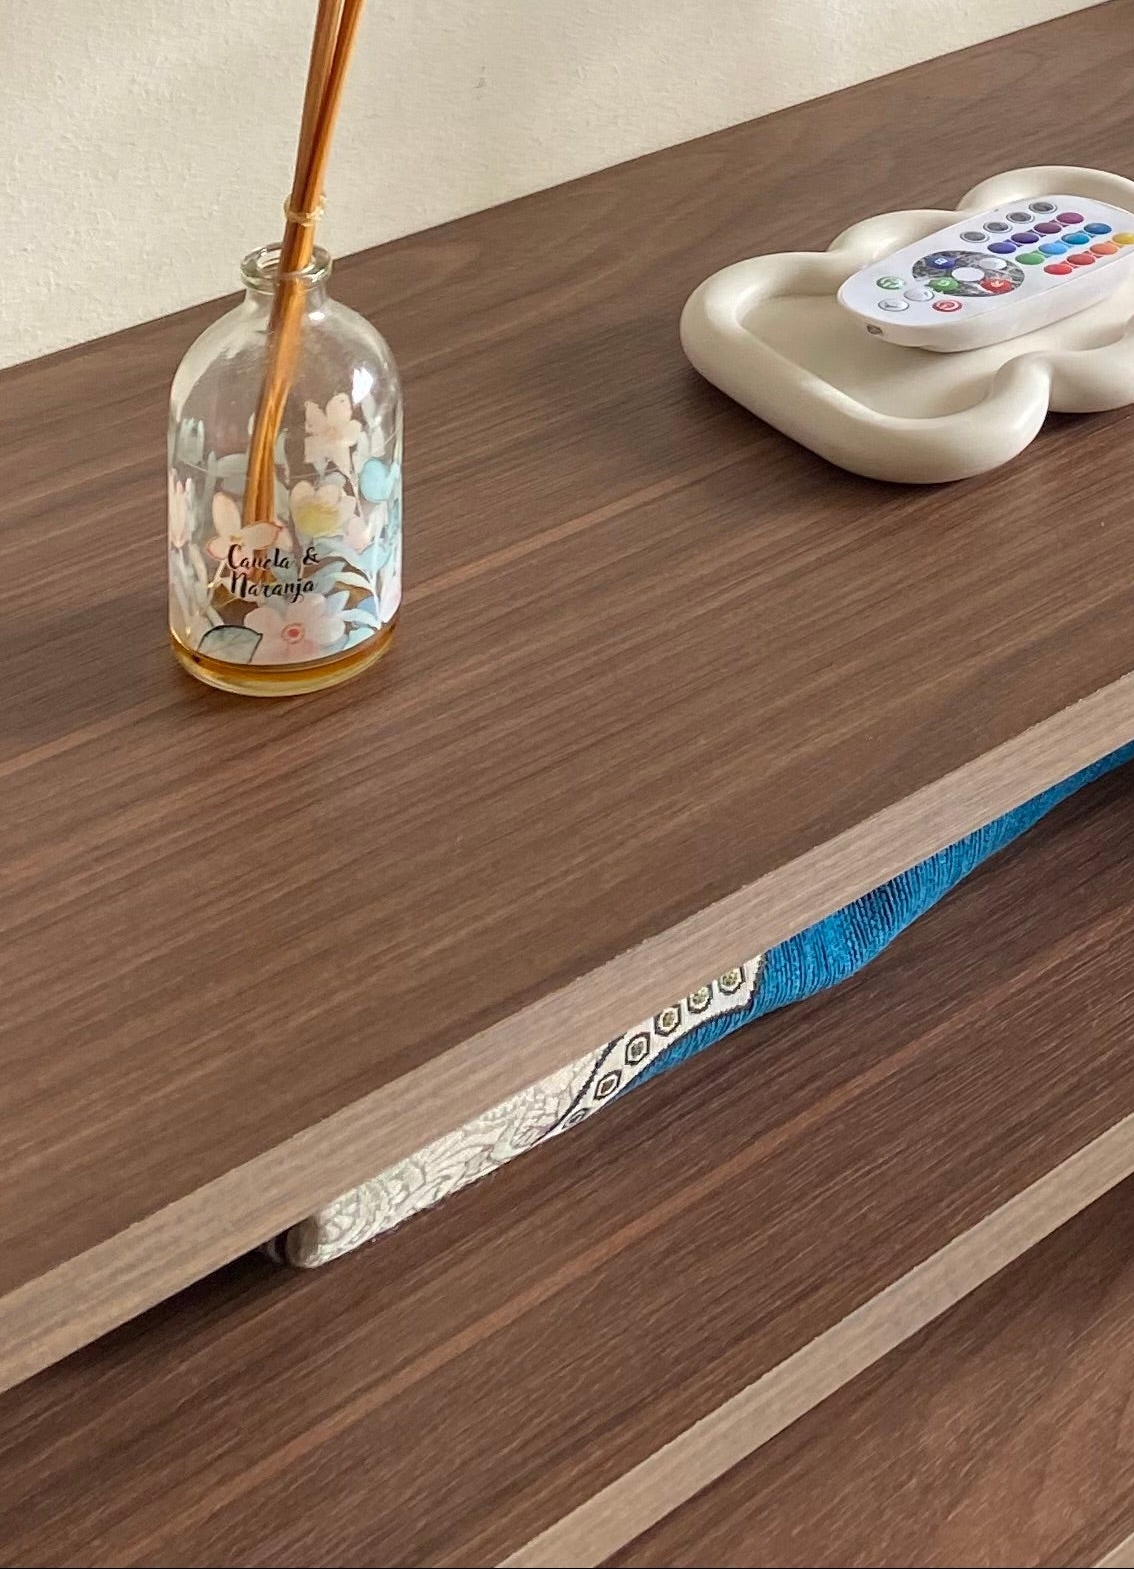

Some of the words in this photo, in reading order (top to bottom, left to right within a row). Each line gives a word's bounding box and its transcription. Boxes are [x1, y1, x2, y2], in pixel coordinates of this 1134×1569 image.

[227, 543, 291, 570] Canela
[302, 546, 321, 566] &
[230, 570, 315, 604] Naranja
